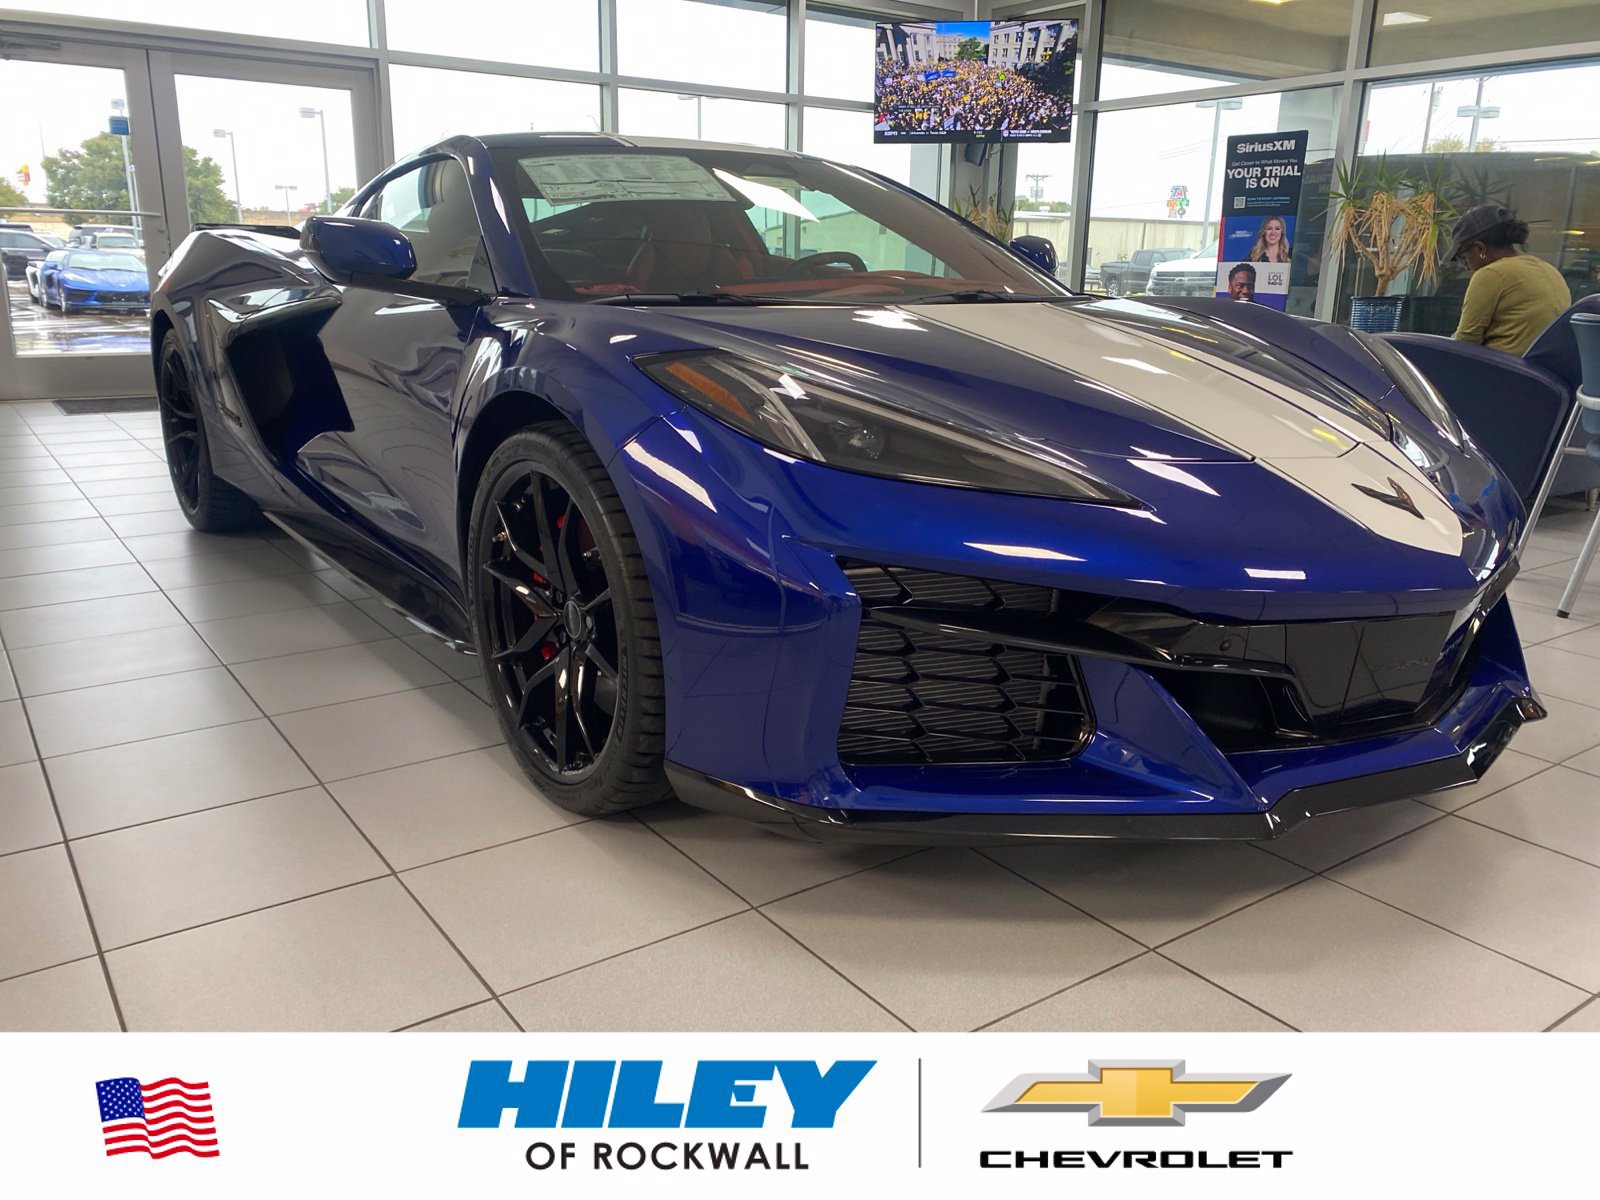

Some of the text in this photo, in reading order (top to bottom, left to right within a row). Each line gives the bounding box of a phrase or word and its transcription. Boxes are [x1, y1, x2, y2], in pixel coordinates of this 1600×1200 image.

[1236, 140, 1296, 154] SiriusXM
[1227, 165, 1301, 179] YOUR TRIAL
[1245, 177, 1279, 189] IS ON
[1268, 274, 1282, 282] LOL
